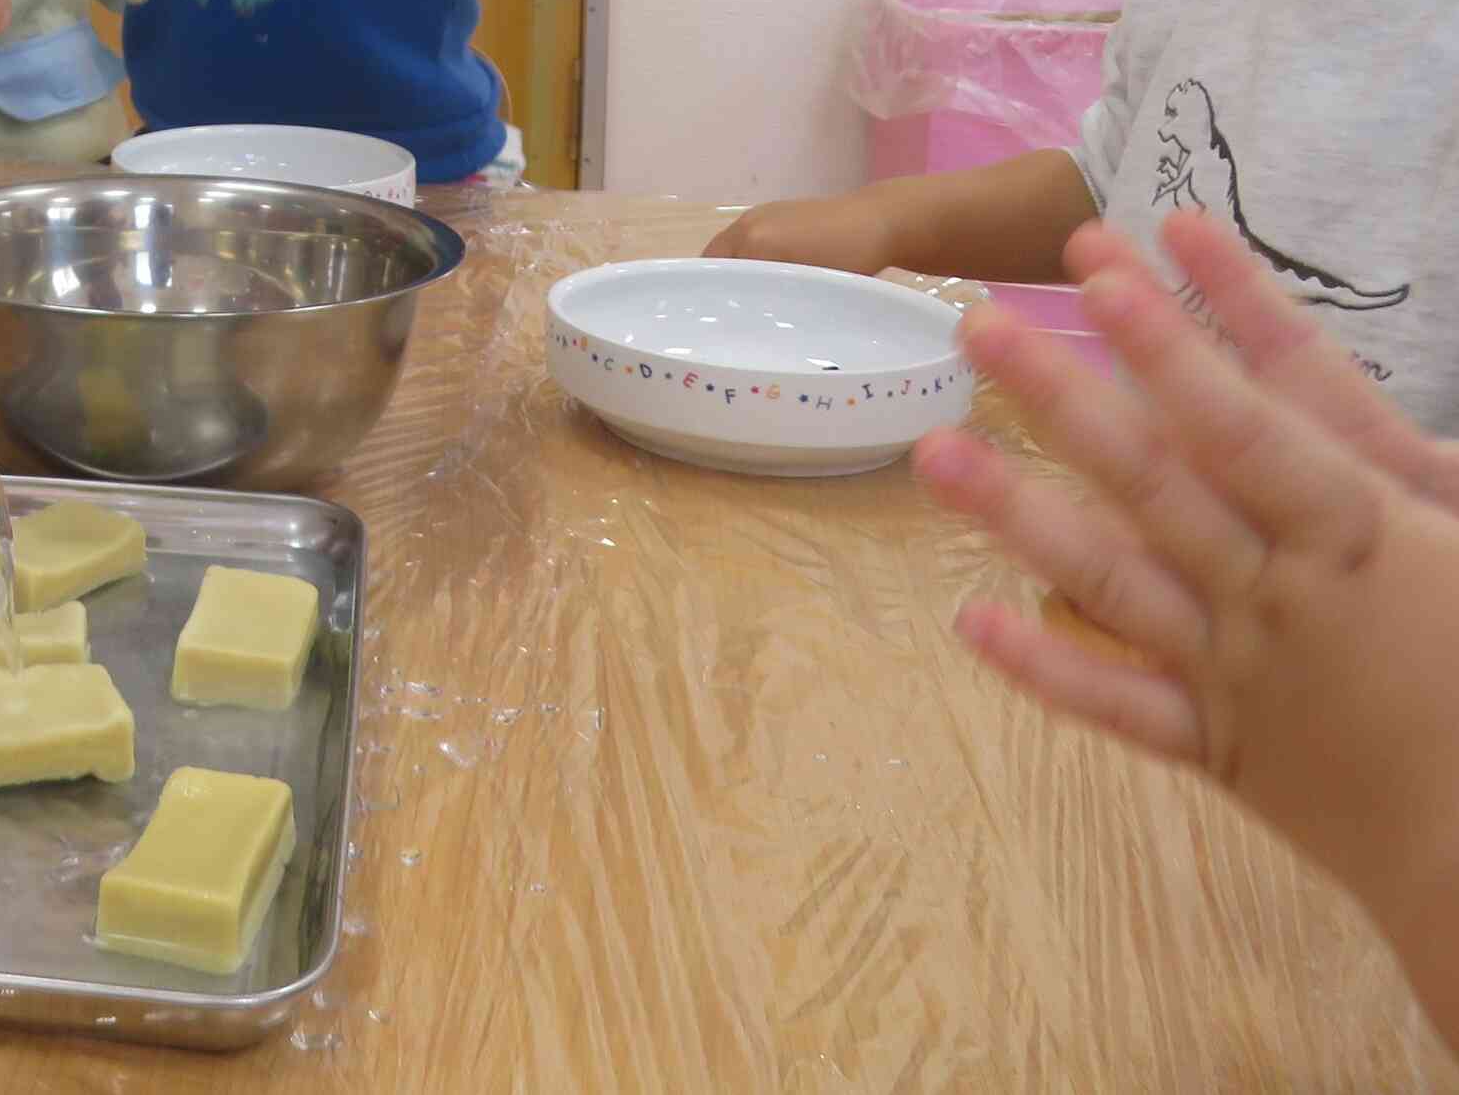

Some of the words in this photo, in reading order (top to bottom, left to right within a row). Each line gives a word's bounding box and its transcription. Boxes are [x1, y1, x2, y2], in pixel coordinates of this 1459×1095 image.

[682, 372, 698, 389] E
[725, 388, 737, 404] F
[816, 396, 832, 411] H
